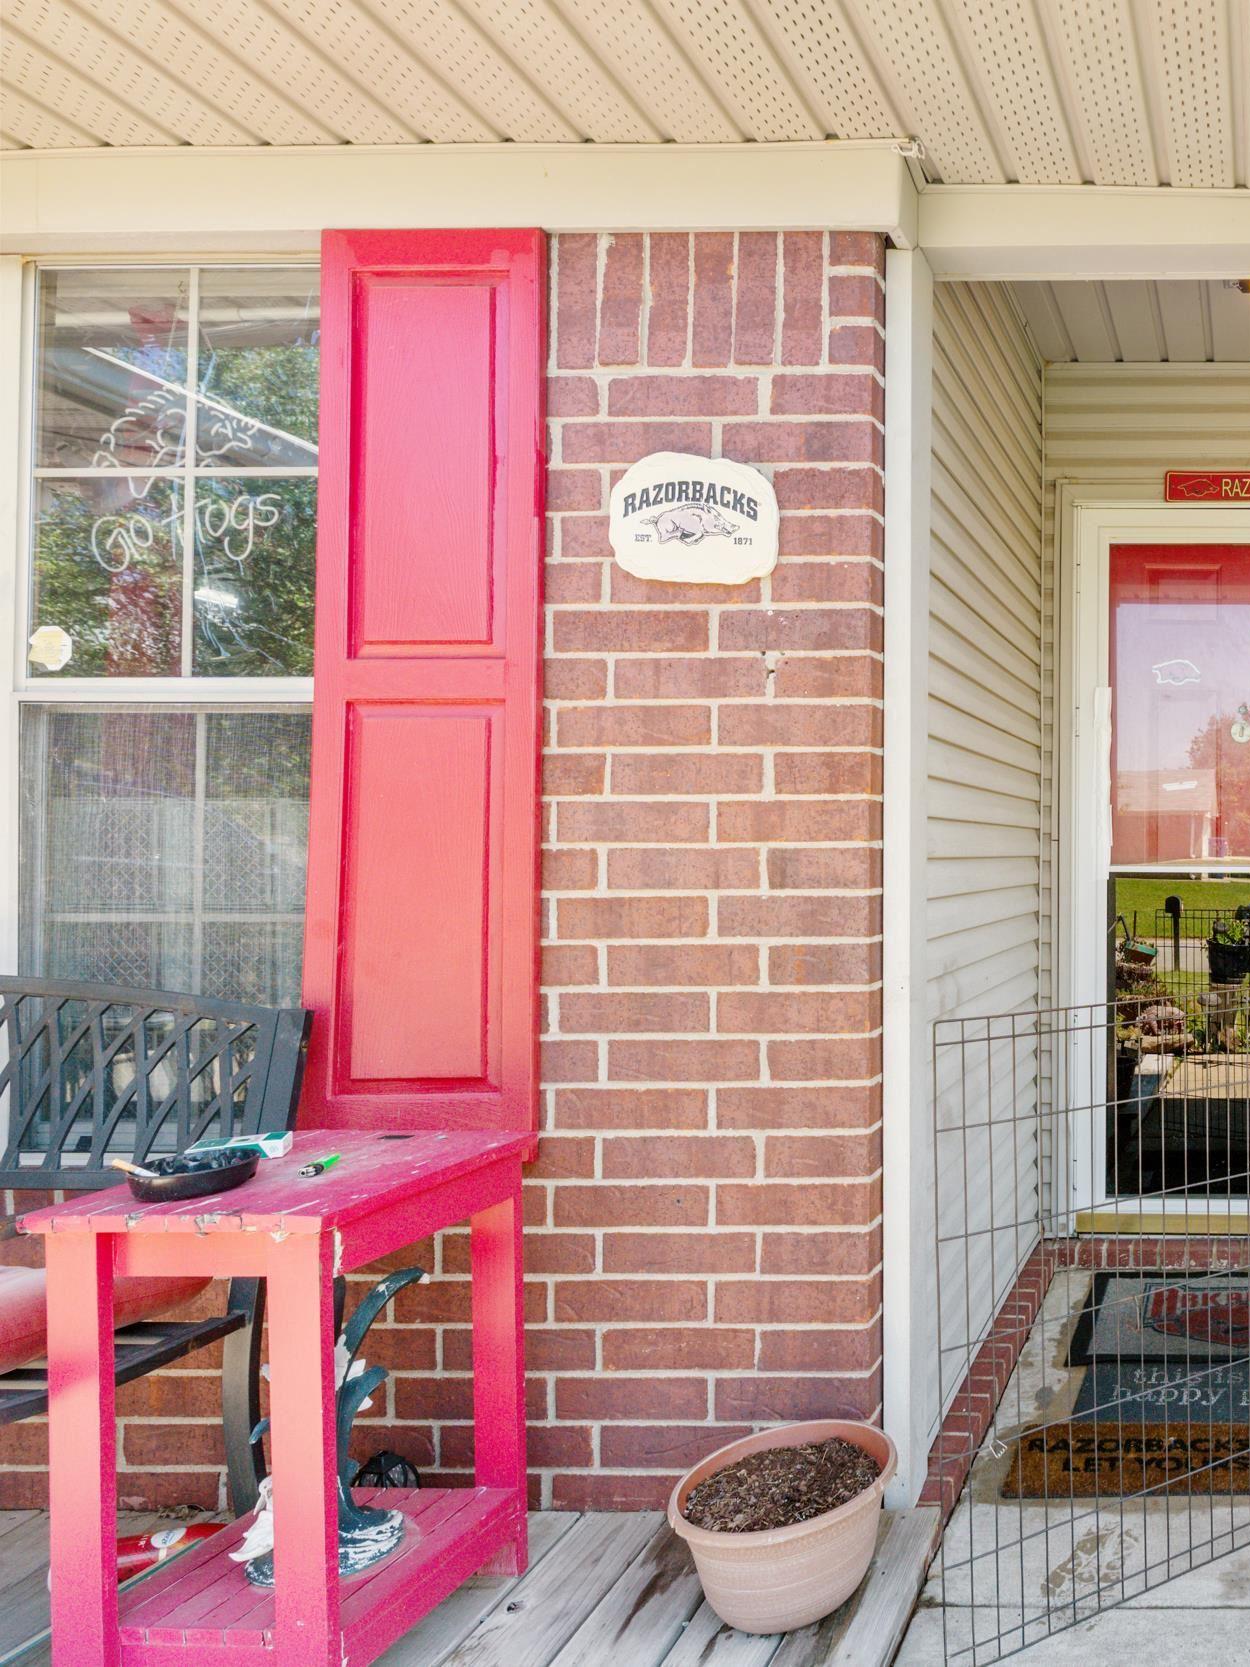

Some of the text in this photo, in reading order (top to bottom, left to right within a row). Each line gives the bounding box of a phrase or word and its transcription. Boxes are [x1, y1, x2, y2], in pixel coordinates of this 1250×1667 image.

[622, 480, 759, 522] RAZORBACKS
[634, 533, 653, 543] EST.
[733, 537, 753, 546] 1871
[1134, 1367, 1202, 1385] this
[1213, 1367, 1244, 1385] is
[1109, 1383, 1227, 1406] happy
[1028, 1437, 1250, 1453] RAZORBACKS
[1062, 1456, 1123, 1473] LET
